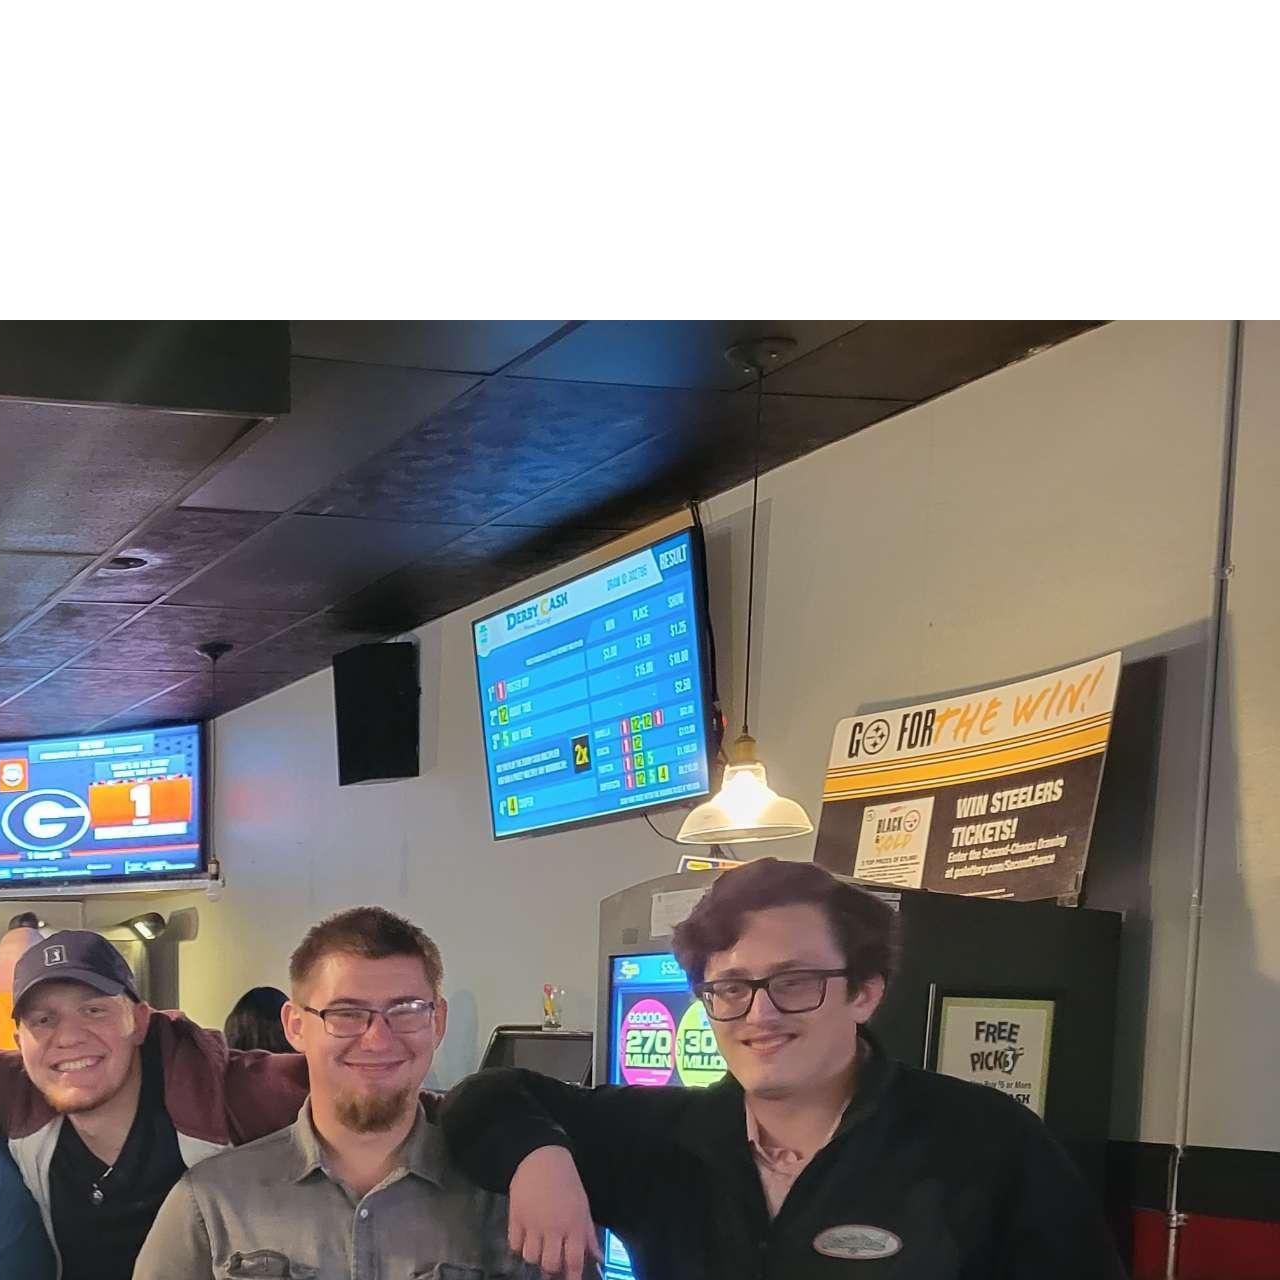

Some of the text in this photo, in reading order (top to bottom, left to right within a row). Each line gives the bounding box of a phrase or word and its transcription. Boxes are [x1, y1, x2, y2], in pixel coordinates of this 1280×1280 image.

[659, 544, 688, 571] RESULT
[506, 604, 538, 630] DERBY
[540, 591, 568, 615] CASH
[896, 708, 937, 751] FOR
[933, 697, 1003, 744] THE
[1012, 665, 1105, 727] WIN!
[956, 778, 1065, 819] WIN STEELERS
[876, 816, 903, 833] BLACK
[951, 818, 1019, 848] TICKETS!
[626, 1029, 719, 1054] 270 30
[974, 1020, 1021, 1044] FREE
[625, 1054, 726, 1070] MILLION MILLIO
[970, 1049, 1004, 1072] PICK
